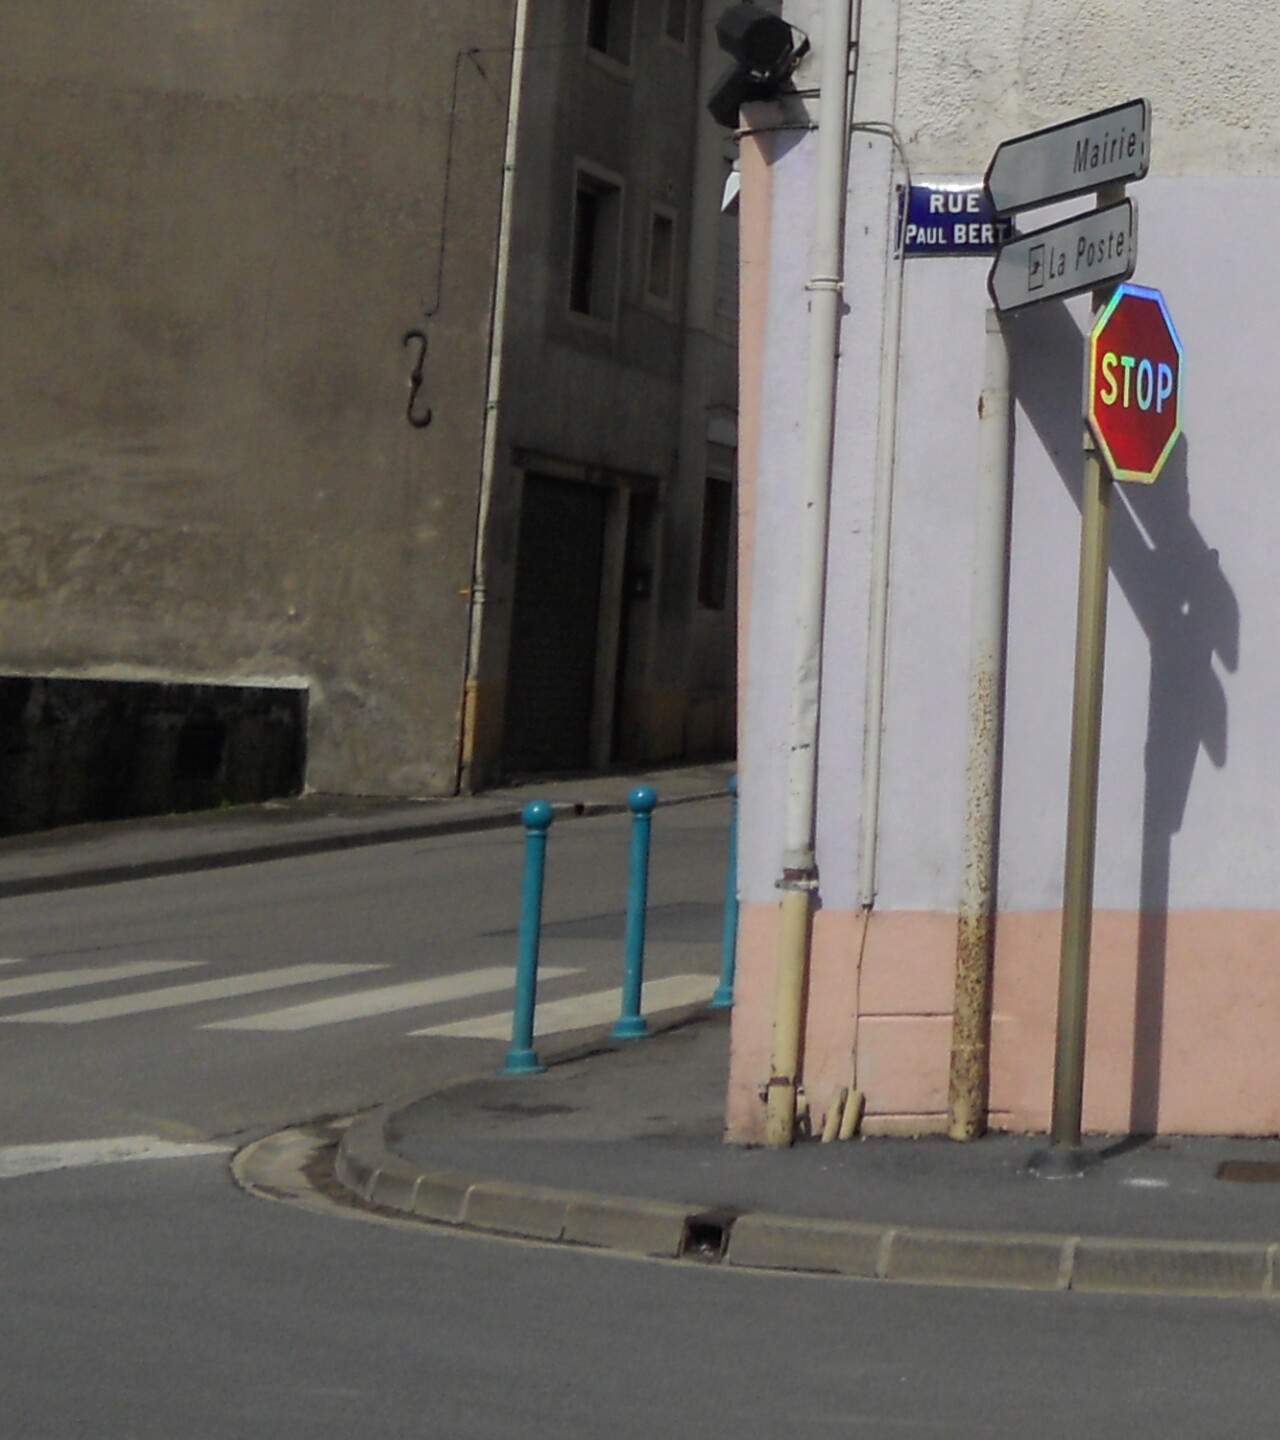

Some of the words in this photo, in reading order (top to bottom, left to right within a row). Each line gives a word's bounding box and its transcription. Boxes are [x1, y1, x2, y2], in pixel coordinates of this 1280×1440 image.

[1073, 127, 1137, 173] Mairie
[929, 193, 980, 214] RUE
[905, 224, 948, 245] PAUL
[1049, 247, 1066, 279] La
[1075, 231, 1125, 271] Poste
[1100, 351, 1173, 413] STOP
